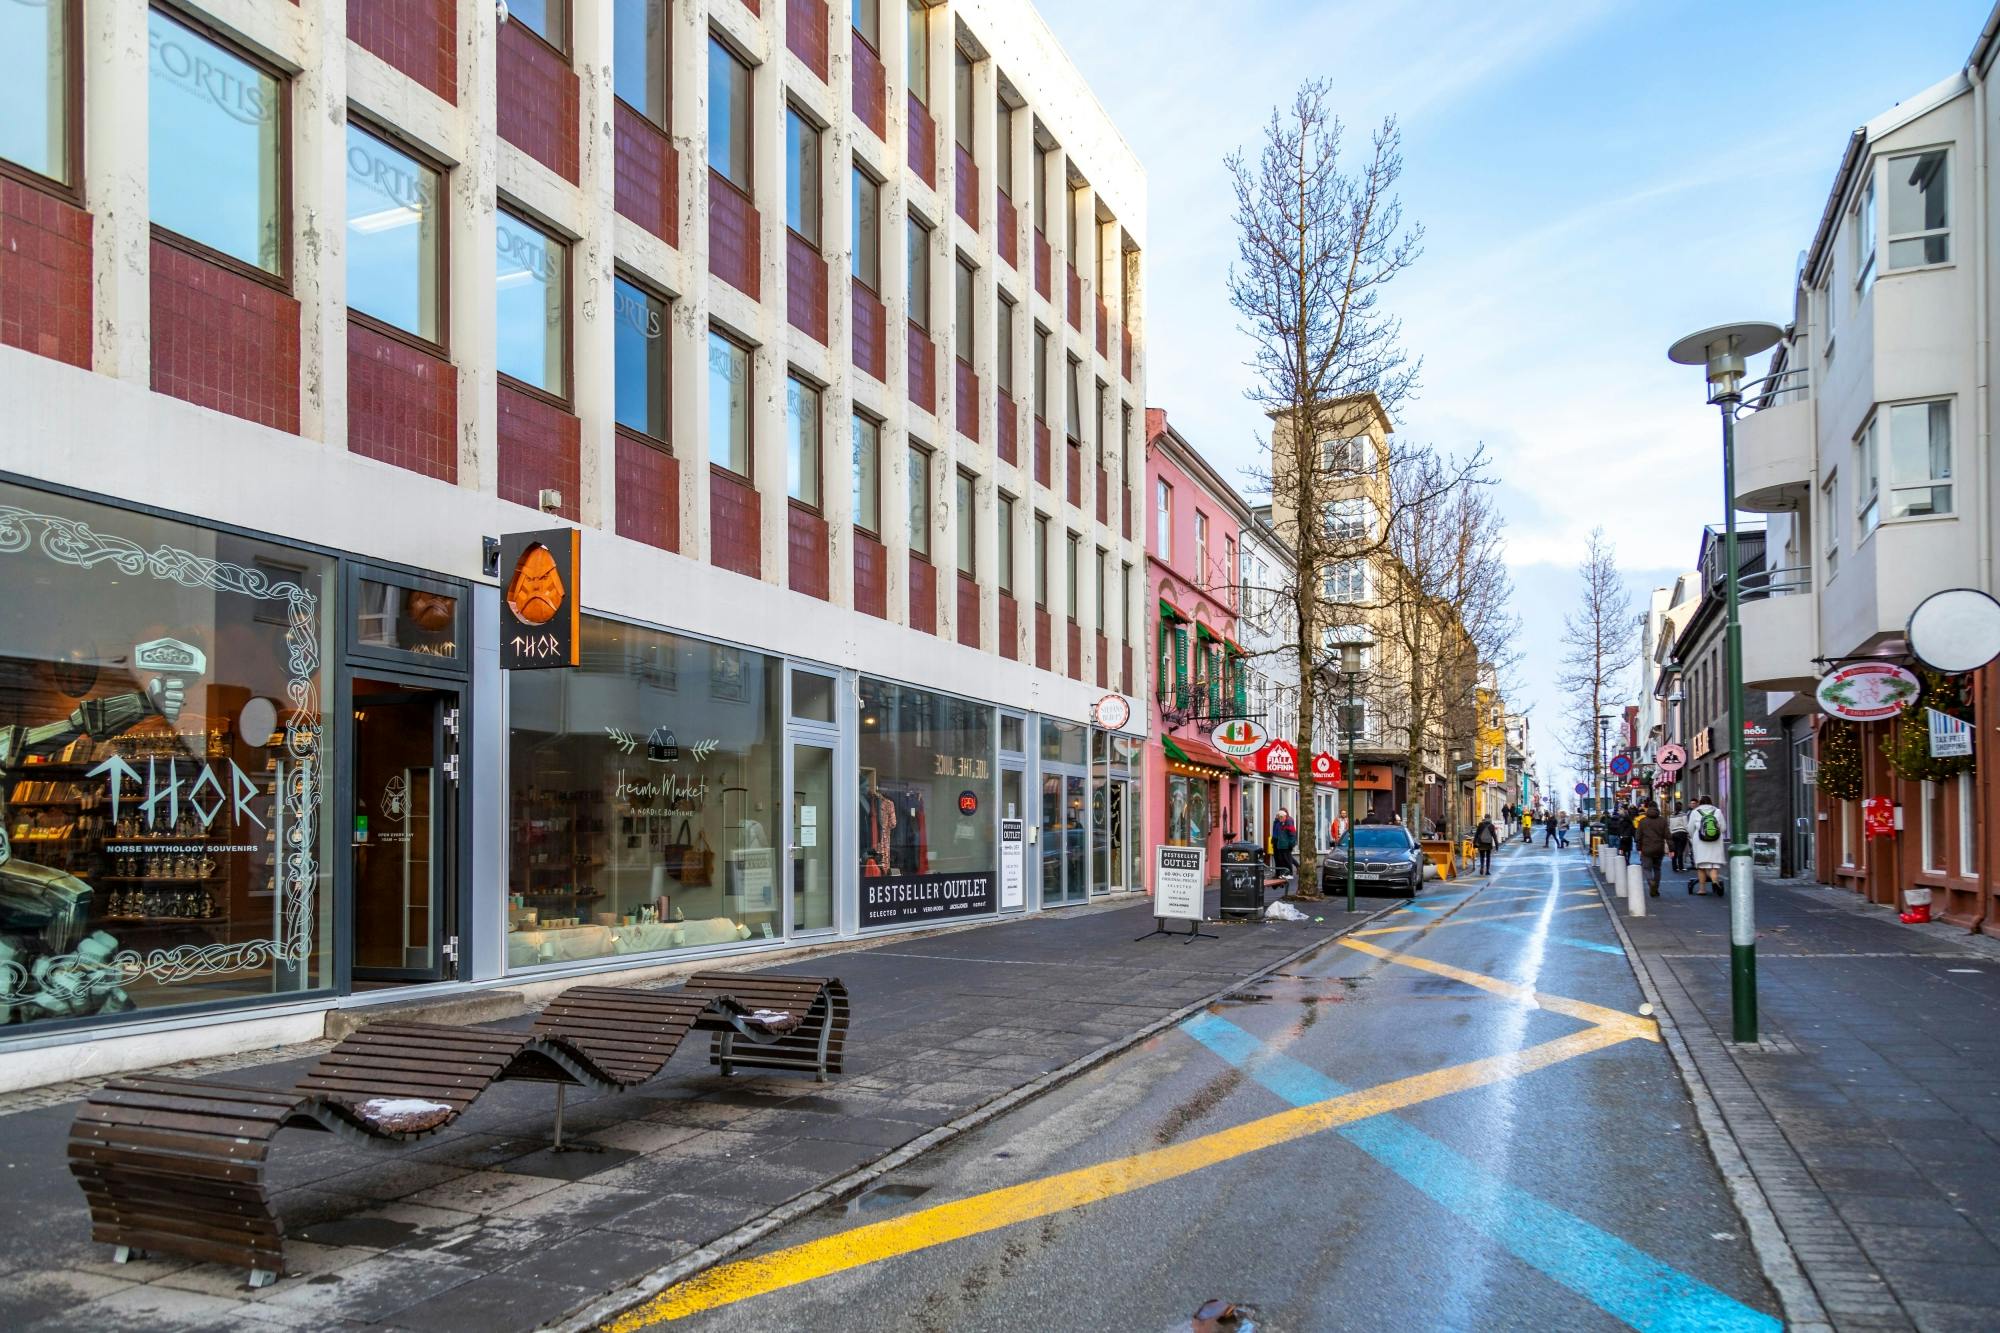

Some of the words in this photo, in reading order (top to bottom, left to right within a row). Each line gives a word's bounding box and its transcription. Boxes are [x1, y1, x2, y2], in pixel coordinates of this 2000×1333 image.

[347, 147, 432, 213] ORTIS
[496, 226, 558, 283] ORTIS
[510, 633, 561, 659] THOR
[85, 754, 267, 830] THOR
[615, 768, 660, 801] Heima
[662, 773, 705, 803] Market
[637, 807, 662, 816] NORDIC
[1003, 831, 1021, 839] OUTLET
[106, 845, 142, 853] NORSE
[145, 845, 204, 854] MYTHOLOGY
[207, 844, 258, 853] SOUVENIRS
[1163, 852, 1198, 860] BESTSELLER
[1163, 859, 1198, 868] OUTLET
[869, 883, 939, 904] BESTSELLER
[943, 878, 987, 899] OUTLET
[869, 909, 897, 918] SELECTED
[902, 907, 917, 915] VILA
